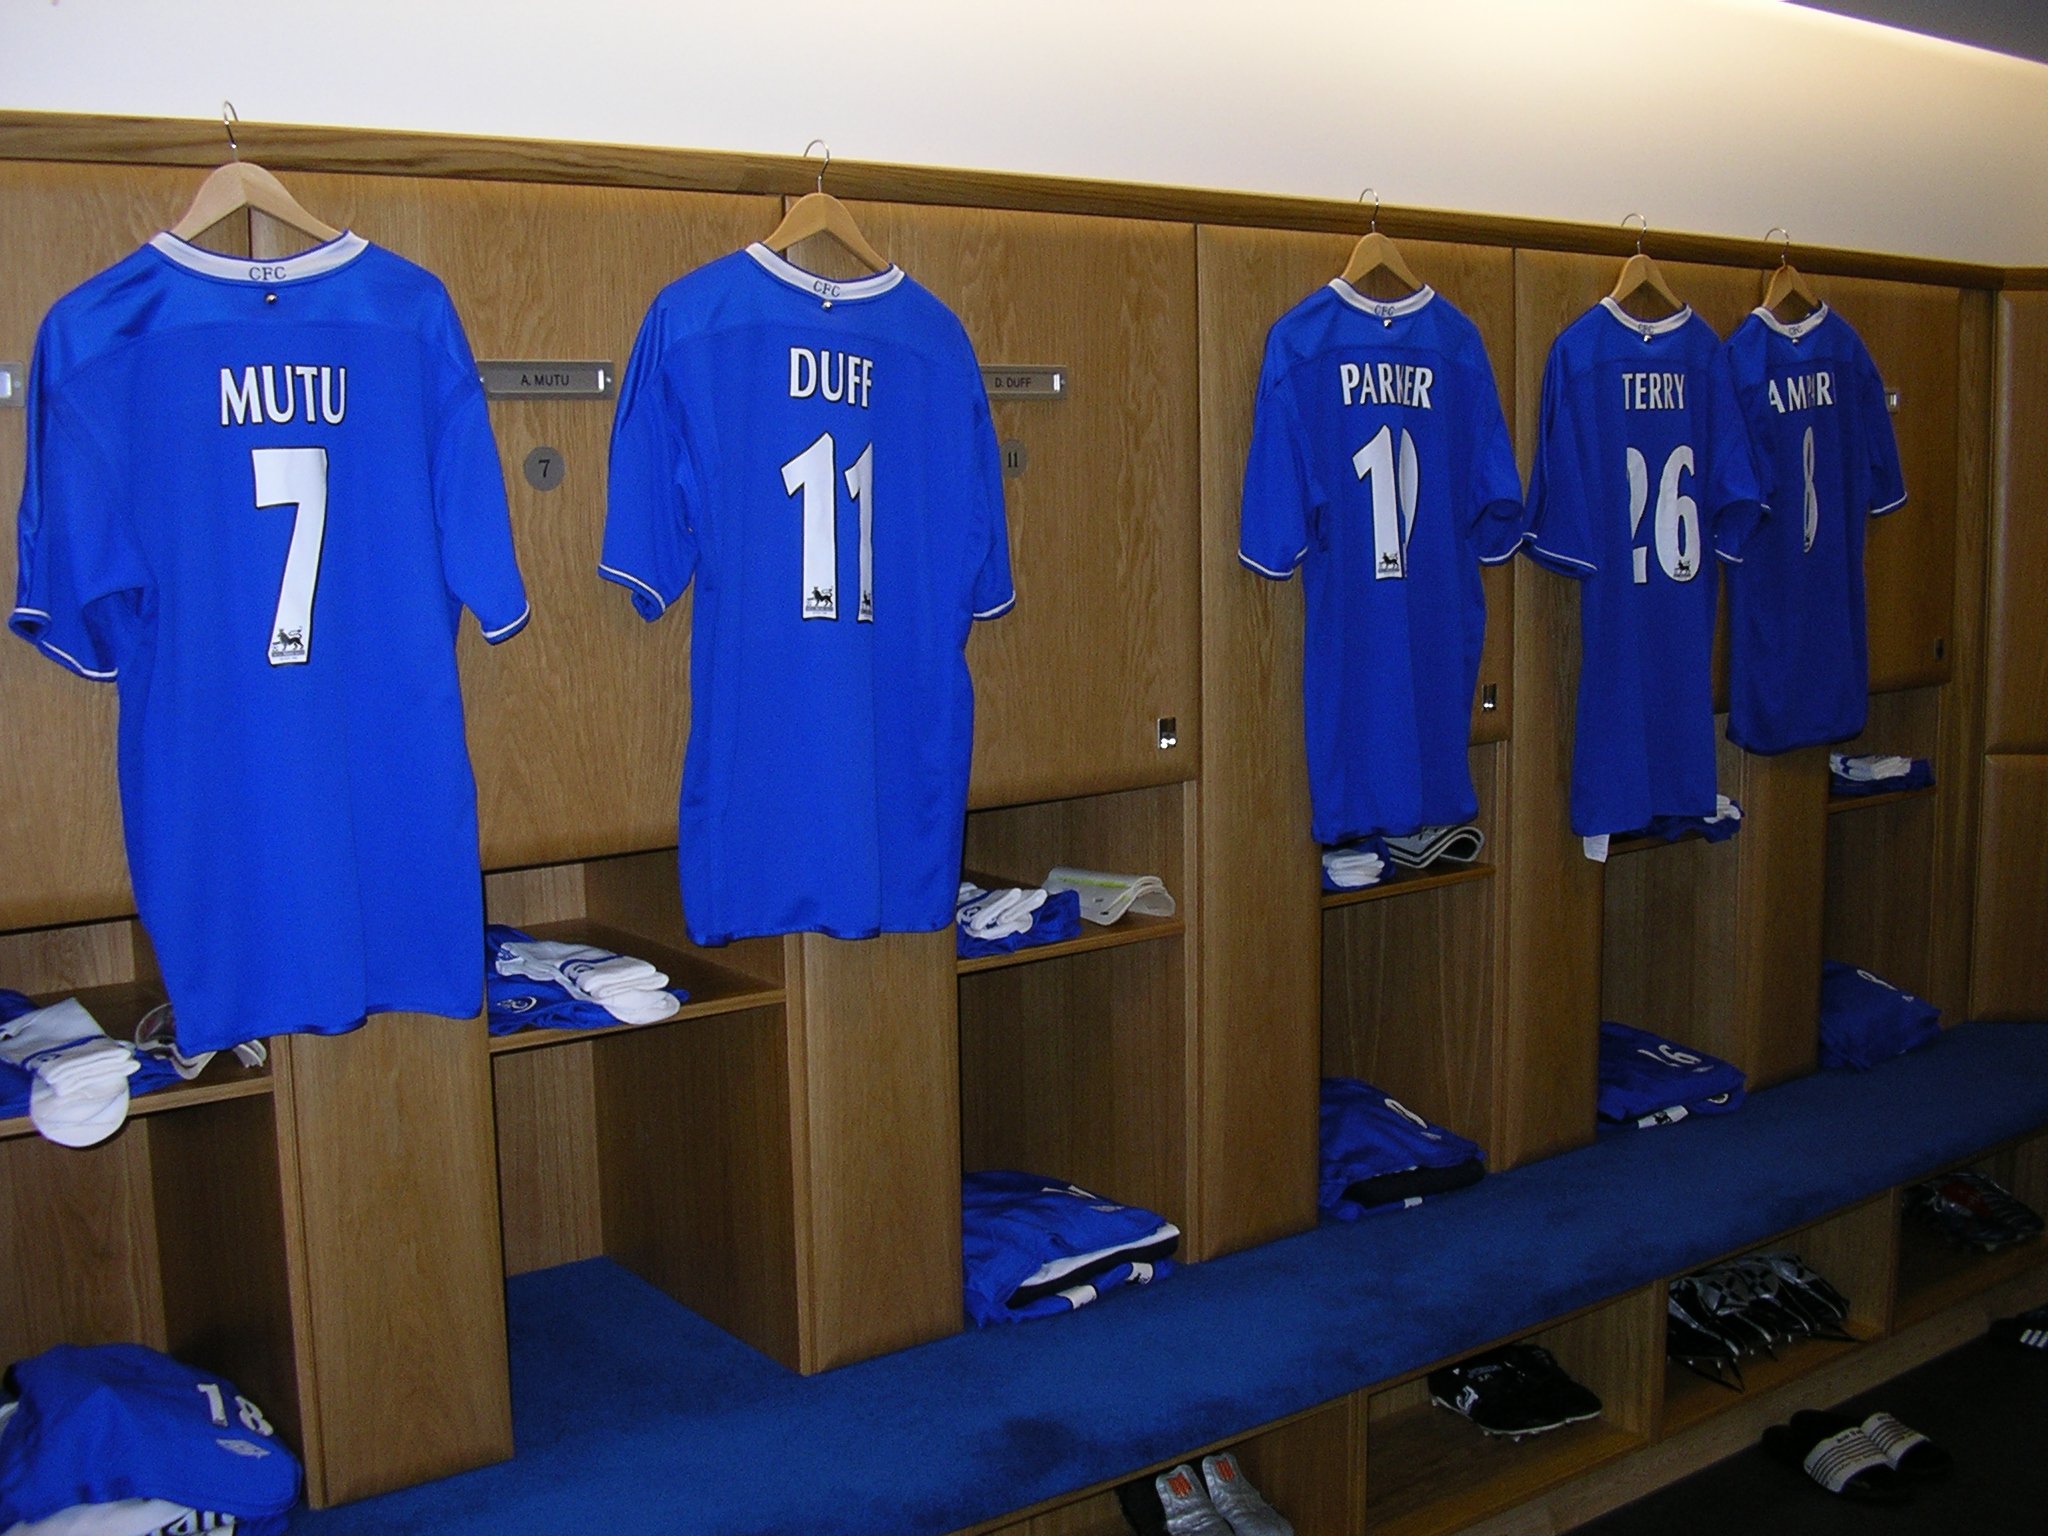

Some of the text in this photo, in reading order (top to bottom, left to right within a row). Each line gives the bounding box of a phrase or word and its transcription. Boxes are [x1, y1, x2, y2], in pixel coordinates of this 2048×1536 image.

[249, 266, 287, 280] CFC
[813, 280, 841, 297] CFC
[534, 374, 570, 386] MUTU
[789, 347, 874, 407] DUFF
[1006, 377, 1032, 388] DUFF
[1622, 372, 1685, 410] TERRY
[220, 365, 347, 426] MUTU
[538, 459, 551, 478] 7
[1008, 451, 1018, 468] 11
[780, 431, 874, 622] 11
[251, 447, 328, 666] 7
[197, 1383, 274, 1436] 18
